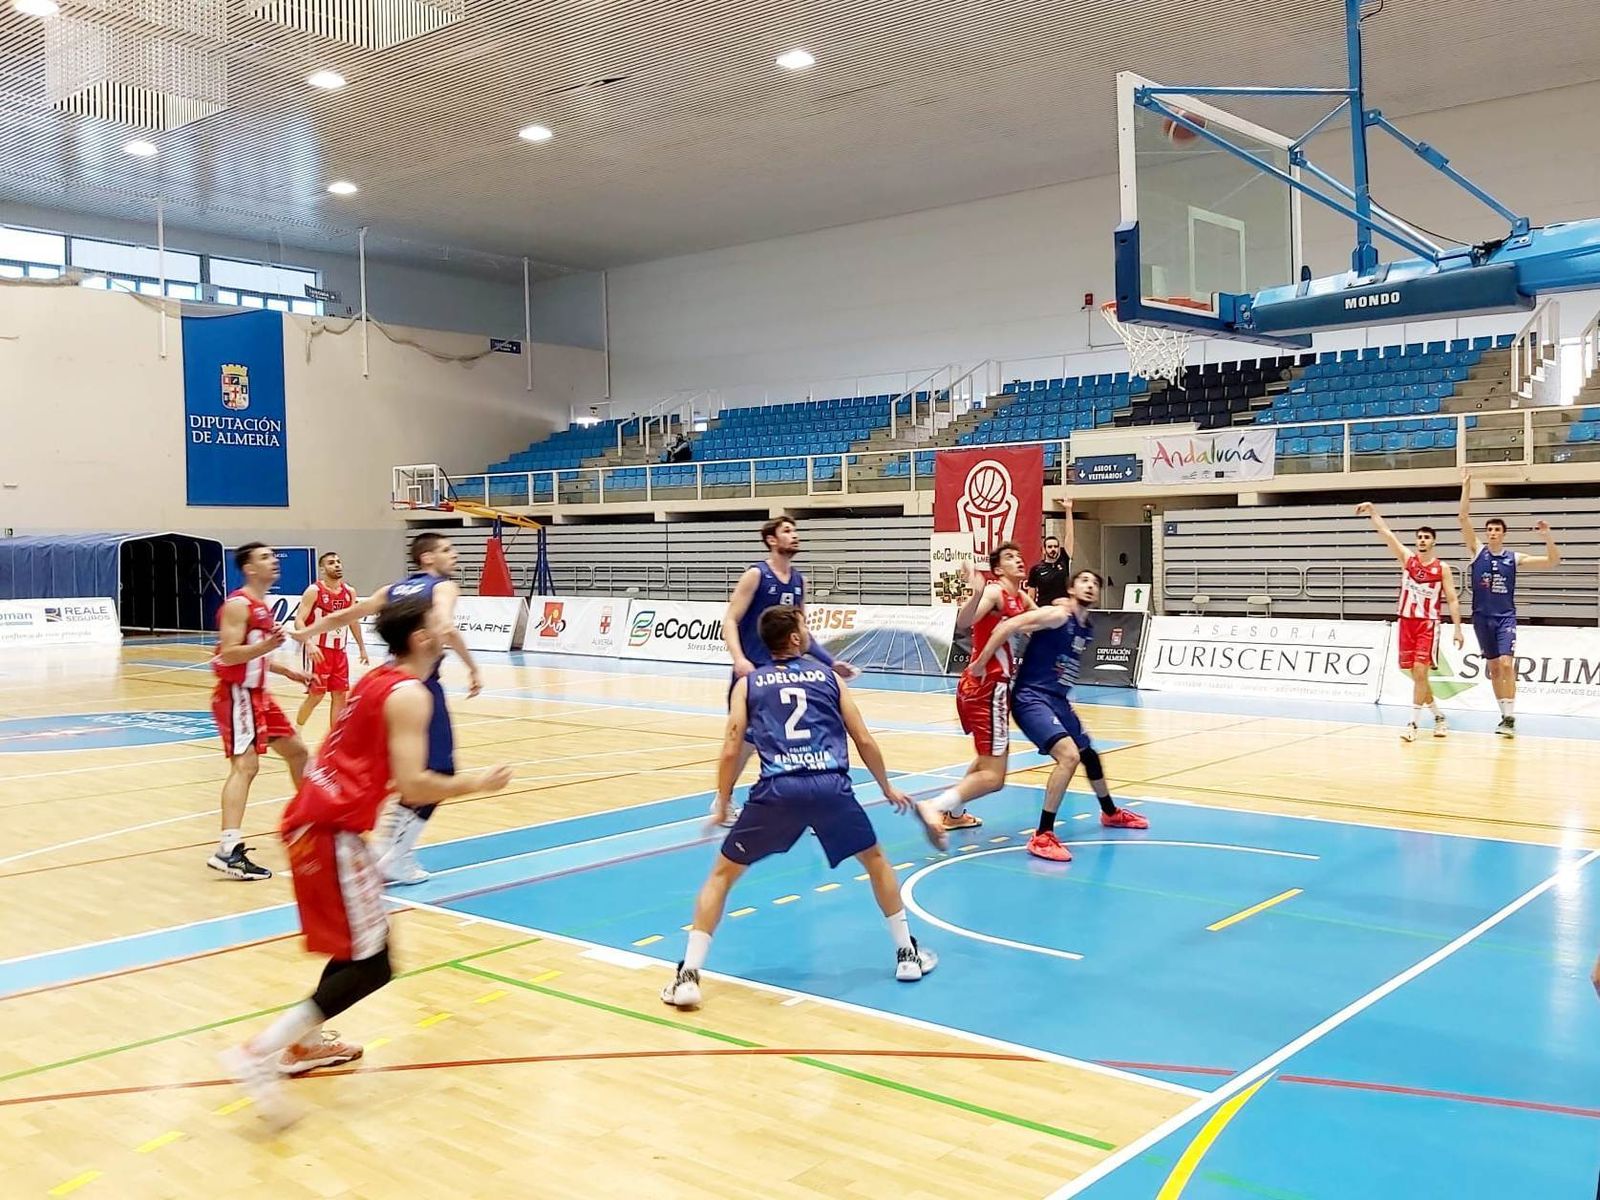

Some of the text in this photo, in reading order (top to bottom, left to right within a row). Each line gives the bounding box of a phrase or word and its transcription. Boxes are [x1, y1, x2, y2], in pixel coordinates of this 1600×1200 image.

[1344, 291, 1401, 309] MONDO
[189, 415, 281, 432] DIPUTACIÓN
[192, 430, 280, 447] DE ALMERÍA
[1152, 437, 1263, 468] Andalucía
[1088, 472, 1123, 480] VESTUARIOS
[1093, 464, 1112, 472] ASEOS
[933, 548, 972, 562] eCoCulture
[64, 606, 108, 615] REALE
[65, 614, 111, 622] SEGUROS
[824, 609, 857, 630] ISE
[687, 642, 706, 651] Stress
[1154, 645, 1371, 676] JURISCENTRO
[1458, 653, 1600, 686] SRLIM
[755, 670, 826, 687] J.DELGADO
[780, 687, 811, 740] 2
